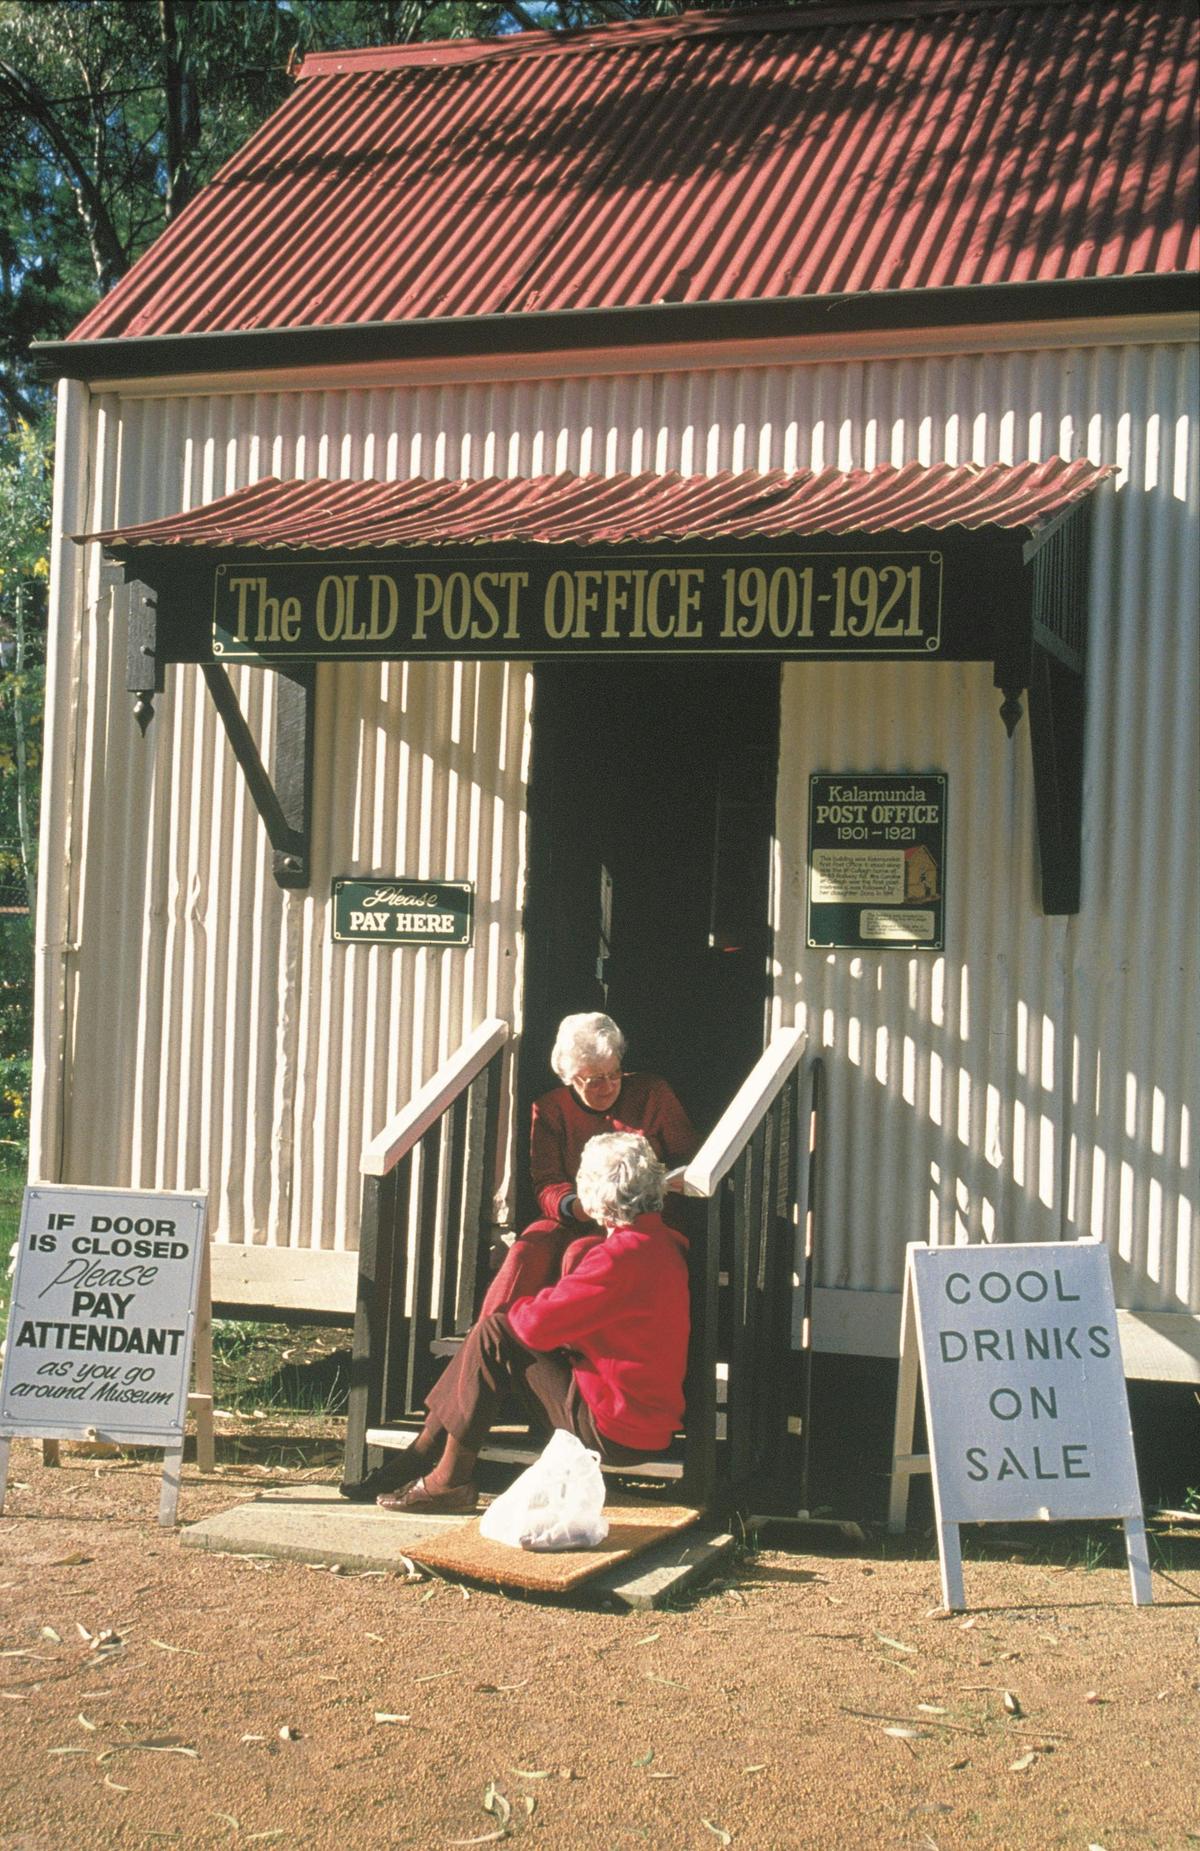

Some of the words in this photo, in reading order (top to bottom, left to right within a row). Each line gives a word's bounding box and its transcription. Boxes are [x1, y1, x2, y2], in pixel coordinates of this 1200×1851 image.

[229, 577, 301, 643] The
[315, 574, 399, 642] OLD
[412, 571, 529, 641] POST
[544, 568, 704, 640] OFFICE
[720, 565, 923, 638] 1901-1921
[828, 785, 927, 802] Kalamunda
[816, 805, 868, 824] POST
[871, 804, 939, 824] OFFICE
[362, 886, 438, 907] Please
[349, 911, 390, 932] PAY
[396, 913, 455, 933] HERE
[47, 1213, 76, 1231] IF
[91, 1215, 177, 1237] DOOR
[29, 1234, 57, 1253] IS
[71, 1236, 190, 1260] CLOSED
[38, 1257, 159, 1299] Please
[944, 1269, 1081, 1304] COOL
[71, 1290, 136, 1320] PAY
[15, 1320, 185, 1356] ATTENDANT
[939, 1325, 1112, 1363] DRINKS
[36, 1360, 73, 1376] as
[72, 1362, 122, 1383] you
[121, 1366, 156, 1386] go
[9, 1381, 95, 1400] around
[92, 1381, 175, 1406] Museum
[989, 1386, 1058, 1421] ON
[965, 1444, 1092, 1482] SALE
